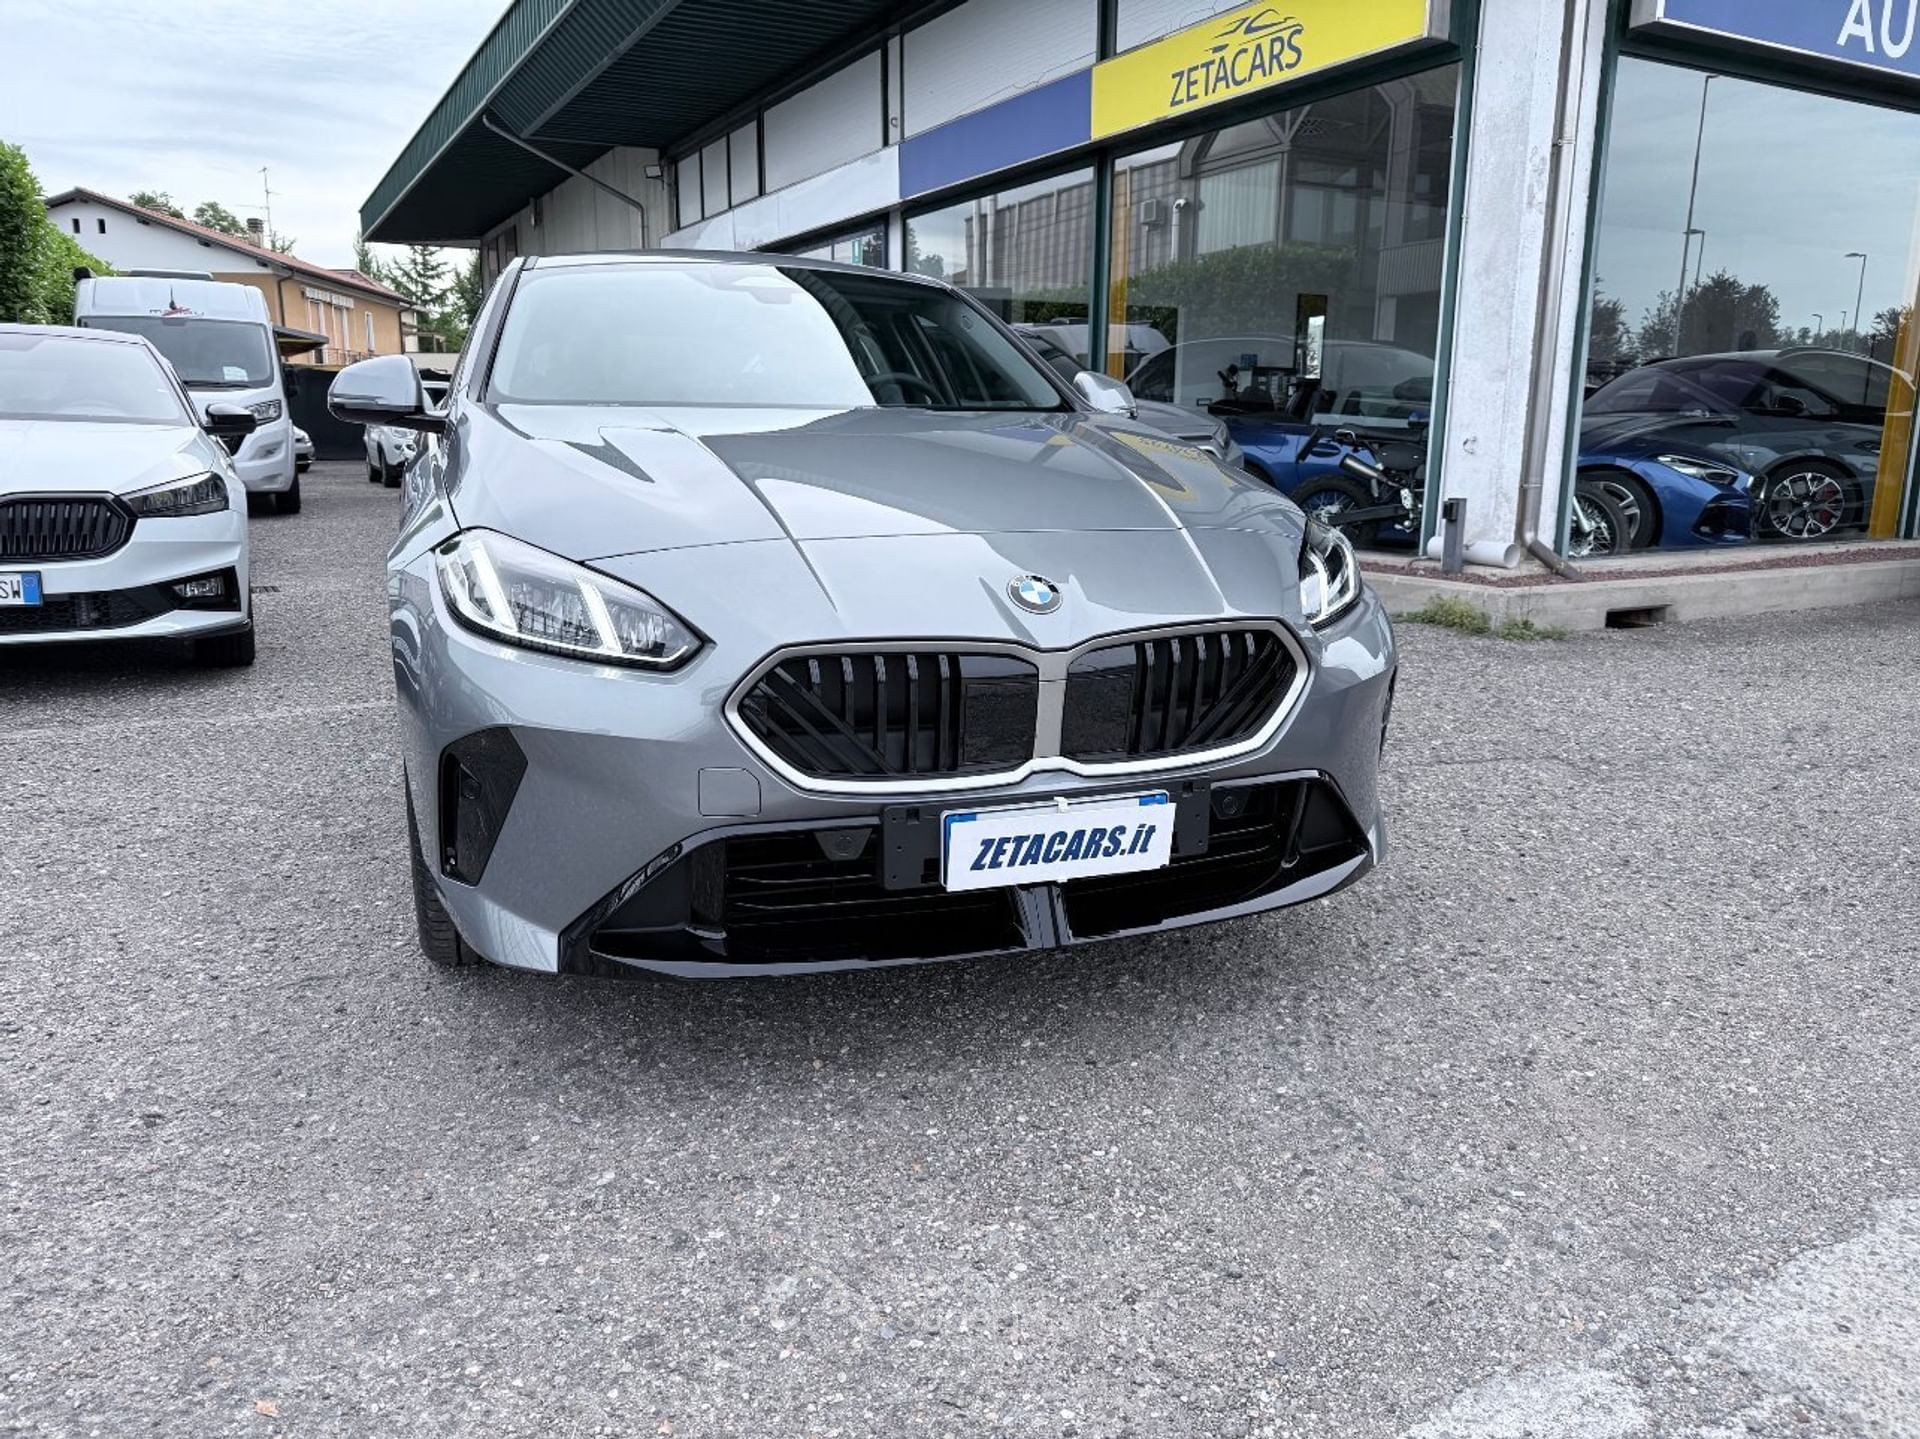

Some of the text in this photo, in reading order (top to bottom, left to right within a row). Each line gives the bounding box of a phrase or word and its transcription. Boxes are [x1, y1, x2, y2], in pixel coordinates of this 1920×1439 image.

[1836, 0, 1918, 58] AU
[1170, 28, 1303, 107] ZETACARS
[969, 823, 1156, 871] ZETACARS.it
